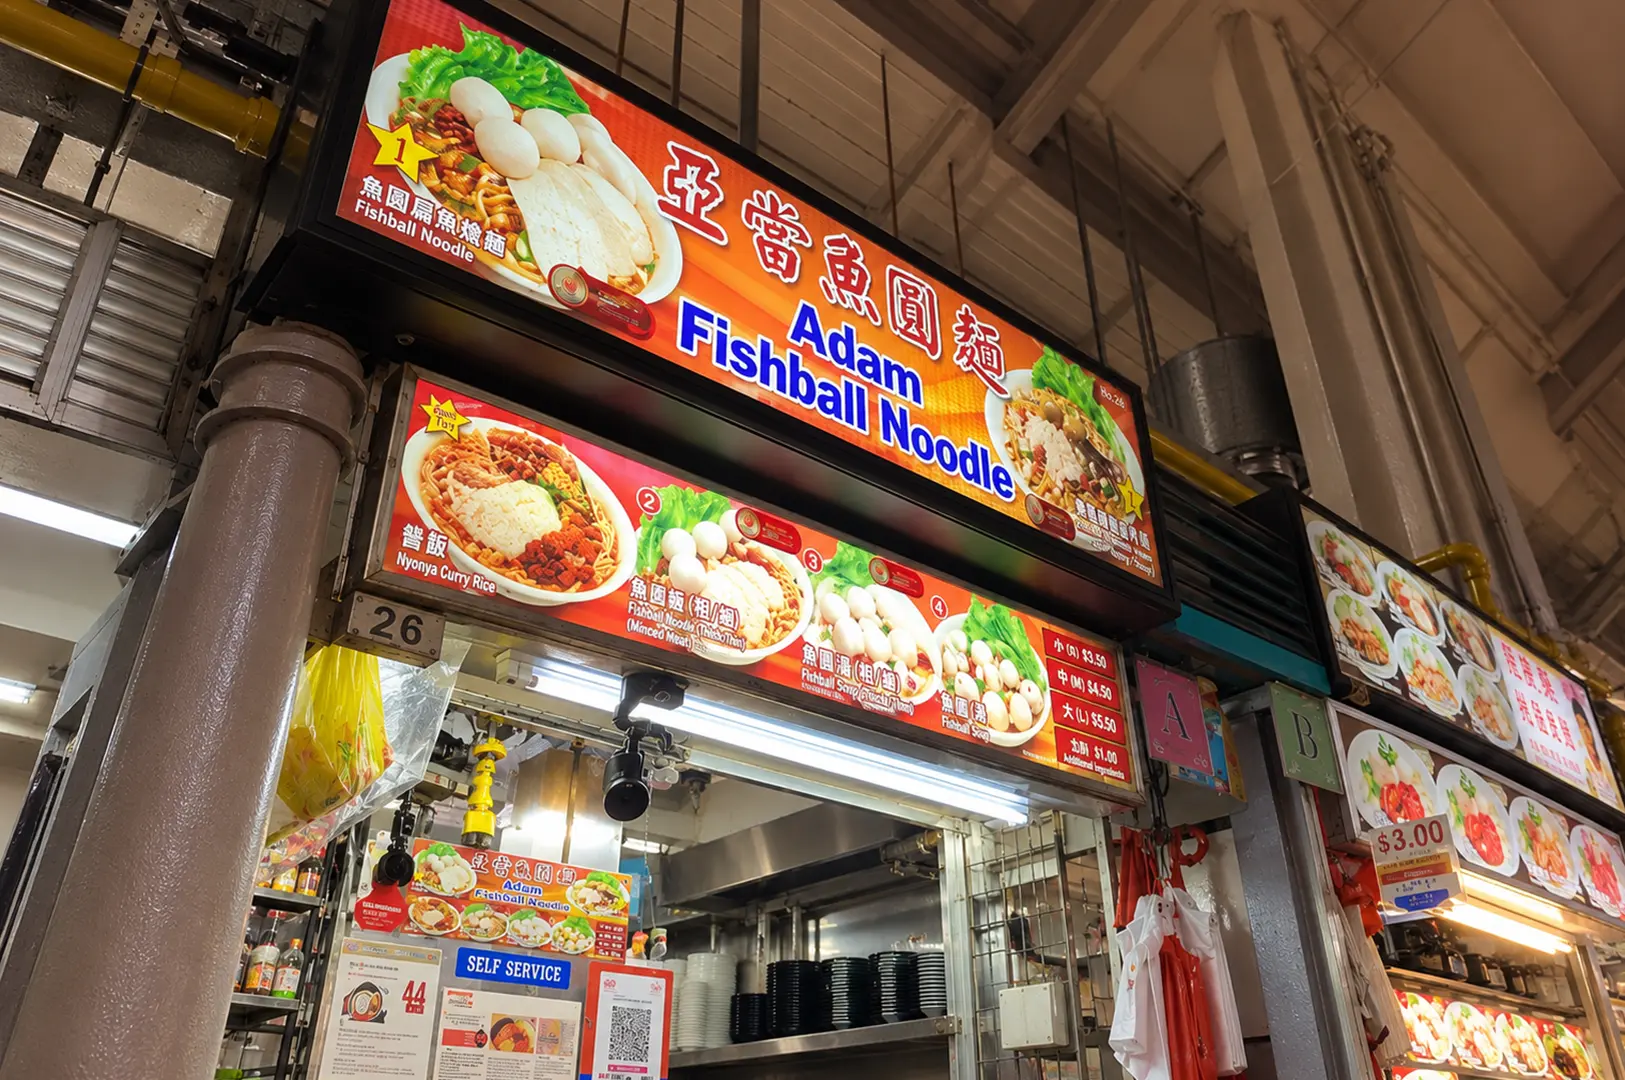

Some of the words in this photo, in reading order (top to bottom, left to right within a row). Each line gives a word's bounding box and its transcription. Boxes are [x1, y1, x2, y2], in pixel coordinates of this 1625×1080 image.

[394, 138, 406, 164] 1
[355, 199, 417, 237] Fishball
[421, 227, 474, 263] Noodle
[789, 301, 923, 405] Adam
[679, 298, 868, 433] Fishball
[880, 396, 1016, 501] Noodle
[643, 493, 655, 510] 2
[396, 551, 437, 577] Nyonya
[440, 565, 471, 589] Curry
[472, 574, 495, 593] Rice
[808, 553, 818, 569] 3
[935, 600, 944, 615] 4
[369, 606, 423, 645] 26
[627, 618, 664, 640] (Minced
[1054, 638, 1064, 652] 小
[1082, 648, 1107, 669] $3.50
[1057, 668, 1068, 686] 中
[1071, 674, 1085, 693] (M)
[1087, 680, 1112, 701] $4.50
[1062, 702, 1074, 720] 大
[1076, 707, 1089, 725] (L)
[1091, 712, 1116, 733] $5.50
[1161, 691, 1192, 742] A
[1290, 710, 1318, 760] B
[1094, 746, 1118, 765] $1.00
[1378, 819, 1444, 855] $3.00
[502, 879, 543, 896] Adam
[467, 955, 501, 975] SELF
[505, 960, 562, 982] SERVICE
